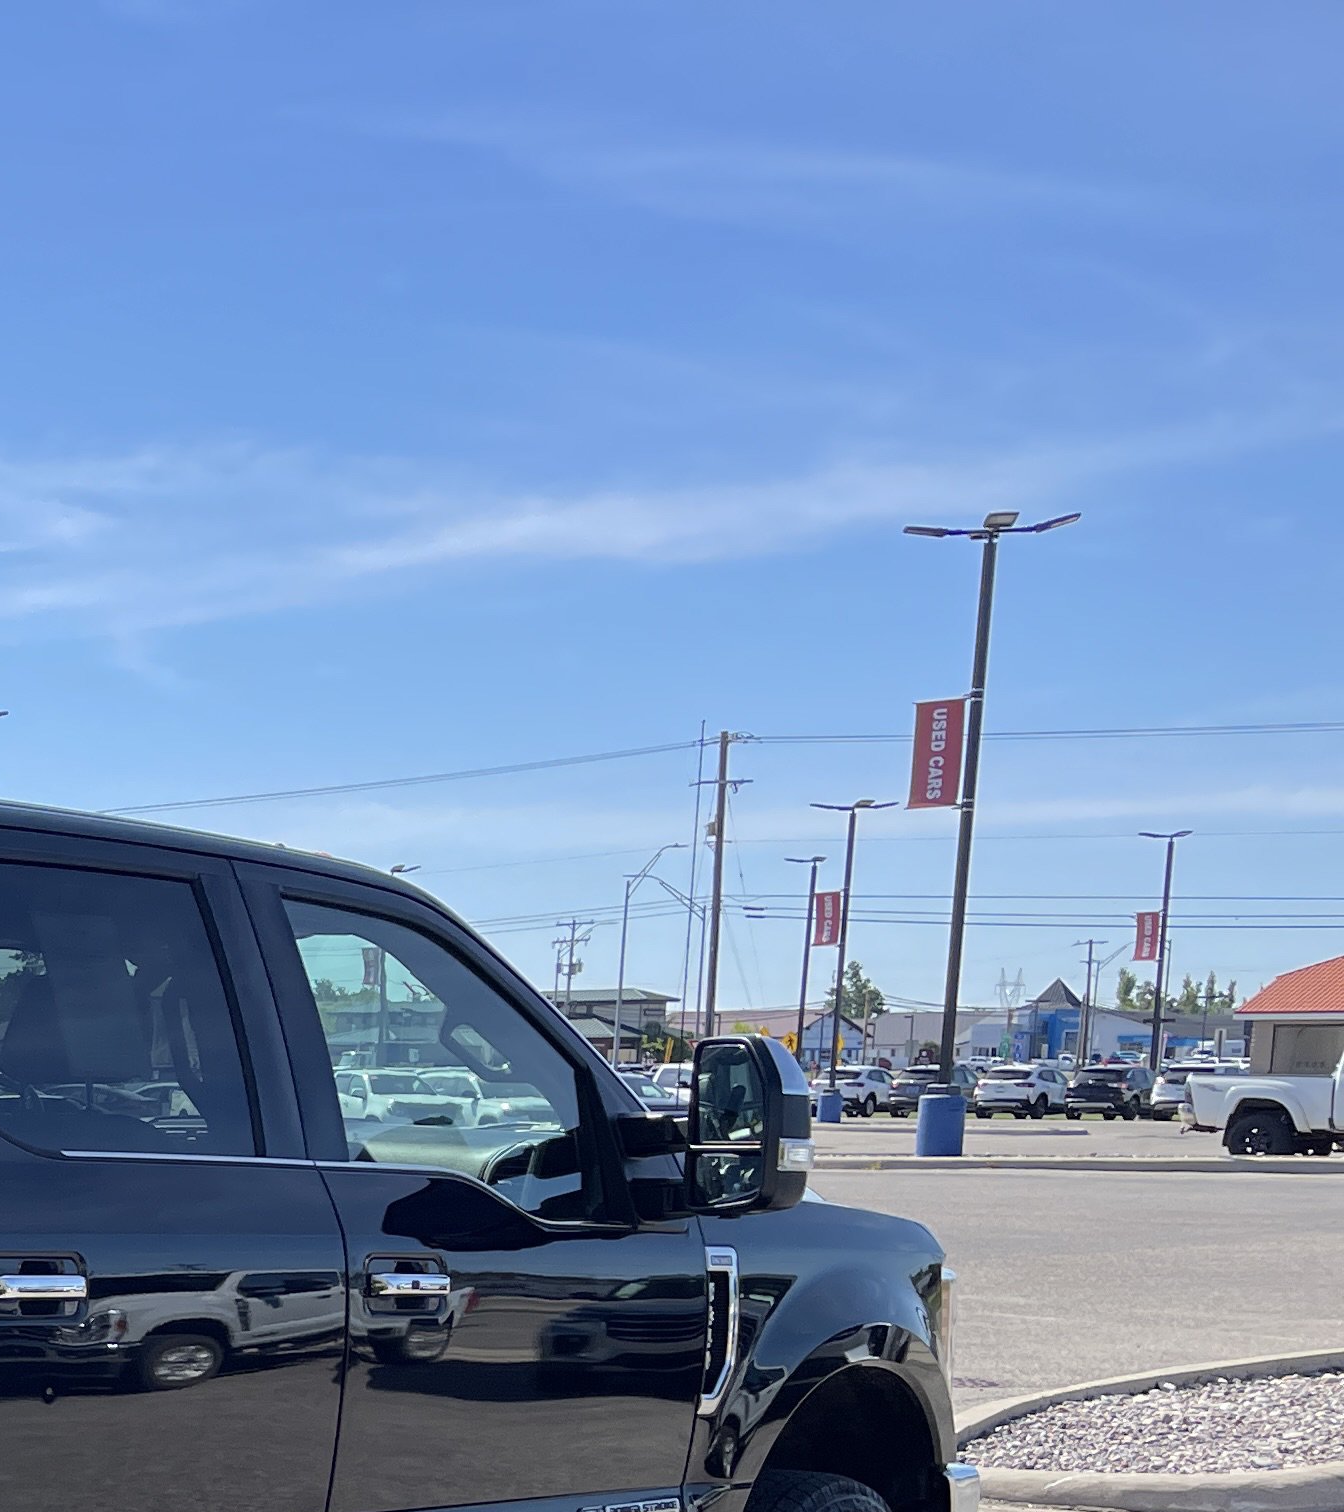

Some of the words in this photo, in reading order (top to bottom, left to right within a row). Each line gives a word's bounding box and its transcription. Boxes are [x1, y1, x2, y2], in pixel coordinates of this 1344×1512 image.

[930, 708, 948, 752] USED
[925, 756, 945, 800] CARS
[642, 1501, 677, 1512] STROKE
